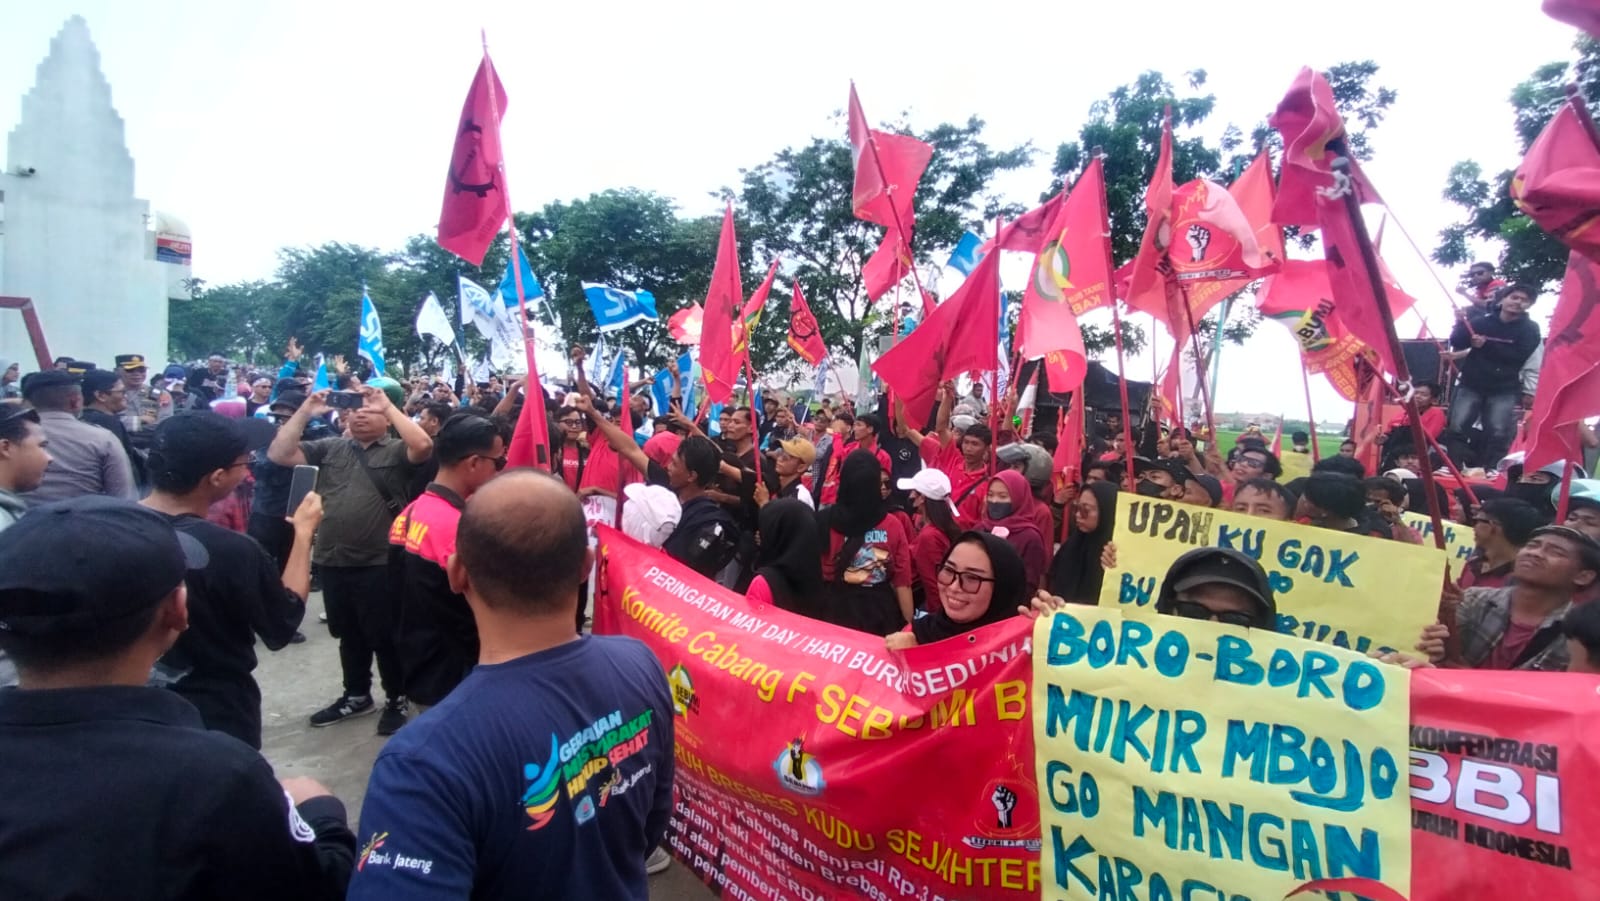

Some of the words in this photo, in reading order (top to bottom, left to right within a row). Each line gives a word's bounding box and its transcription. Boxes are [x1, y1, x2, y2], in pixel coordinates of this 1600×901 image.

[1127, 501, 1214, 547] UPAH
[1217, 524, 1266, 560] KU
[1276, 539, 1361, 588] GAK
[621, 585, 689, 643] Komite
[688, 630, 784, 702] Cabang
[787, 671, 816, 703] F
[994, 679, 1028, 722] B
[644, 566, 734, 621] PERINGATAN
[729, 611, 768, 634] MAY
[762, 623, 800, 646] DAY
[793, 634, 806, 649] /
[806, 637, 849, 665] HARI
[1046, 612, 1386, 711] BORO-BORO
[1046, 683, 1207, 774] MIKIR
[1221, 719, 1399, 812] MBOJO
[368, 850, 391, 865] Bank
[392, 853, 433, 875] Jateng
[669, 834, 692, 859] dan
[675, 802, 714, 834] dalam
[716, 826, 763, 870] bentuk
[689, 831, 719, 857] atau
[707, 765, 799, 816] BREBES
[803, 804, 875, 851] KUDU
[886, 828, 1042, 892] SEJAHTER
[722, 814, 749, 844] Laki
[735, 807, 815, 872] Kabupaten
[744, 800, 799, 842] Brebes
[803, 838, 885, 876] menjadi
[1046, 760, 1100, 818] GO
[1132, 785, 1382, 893] MANGAN
[1464, 822, 1572, 871] INDONESIA
